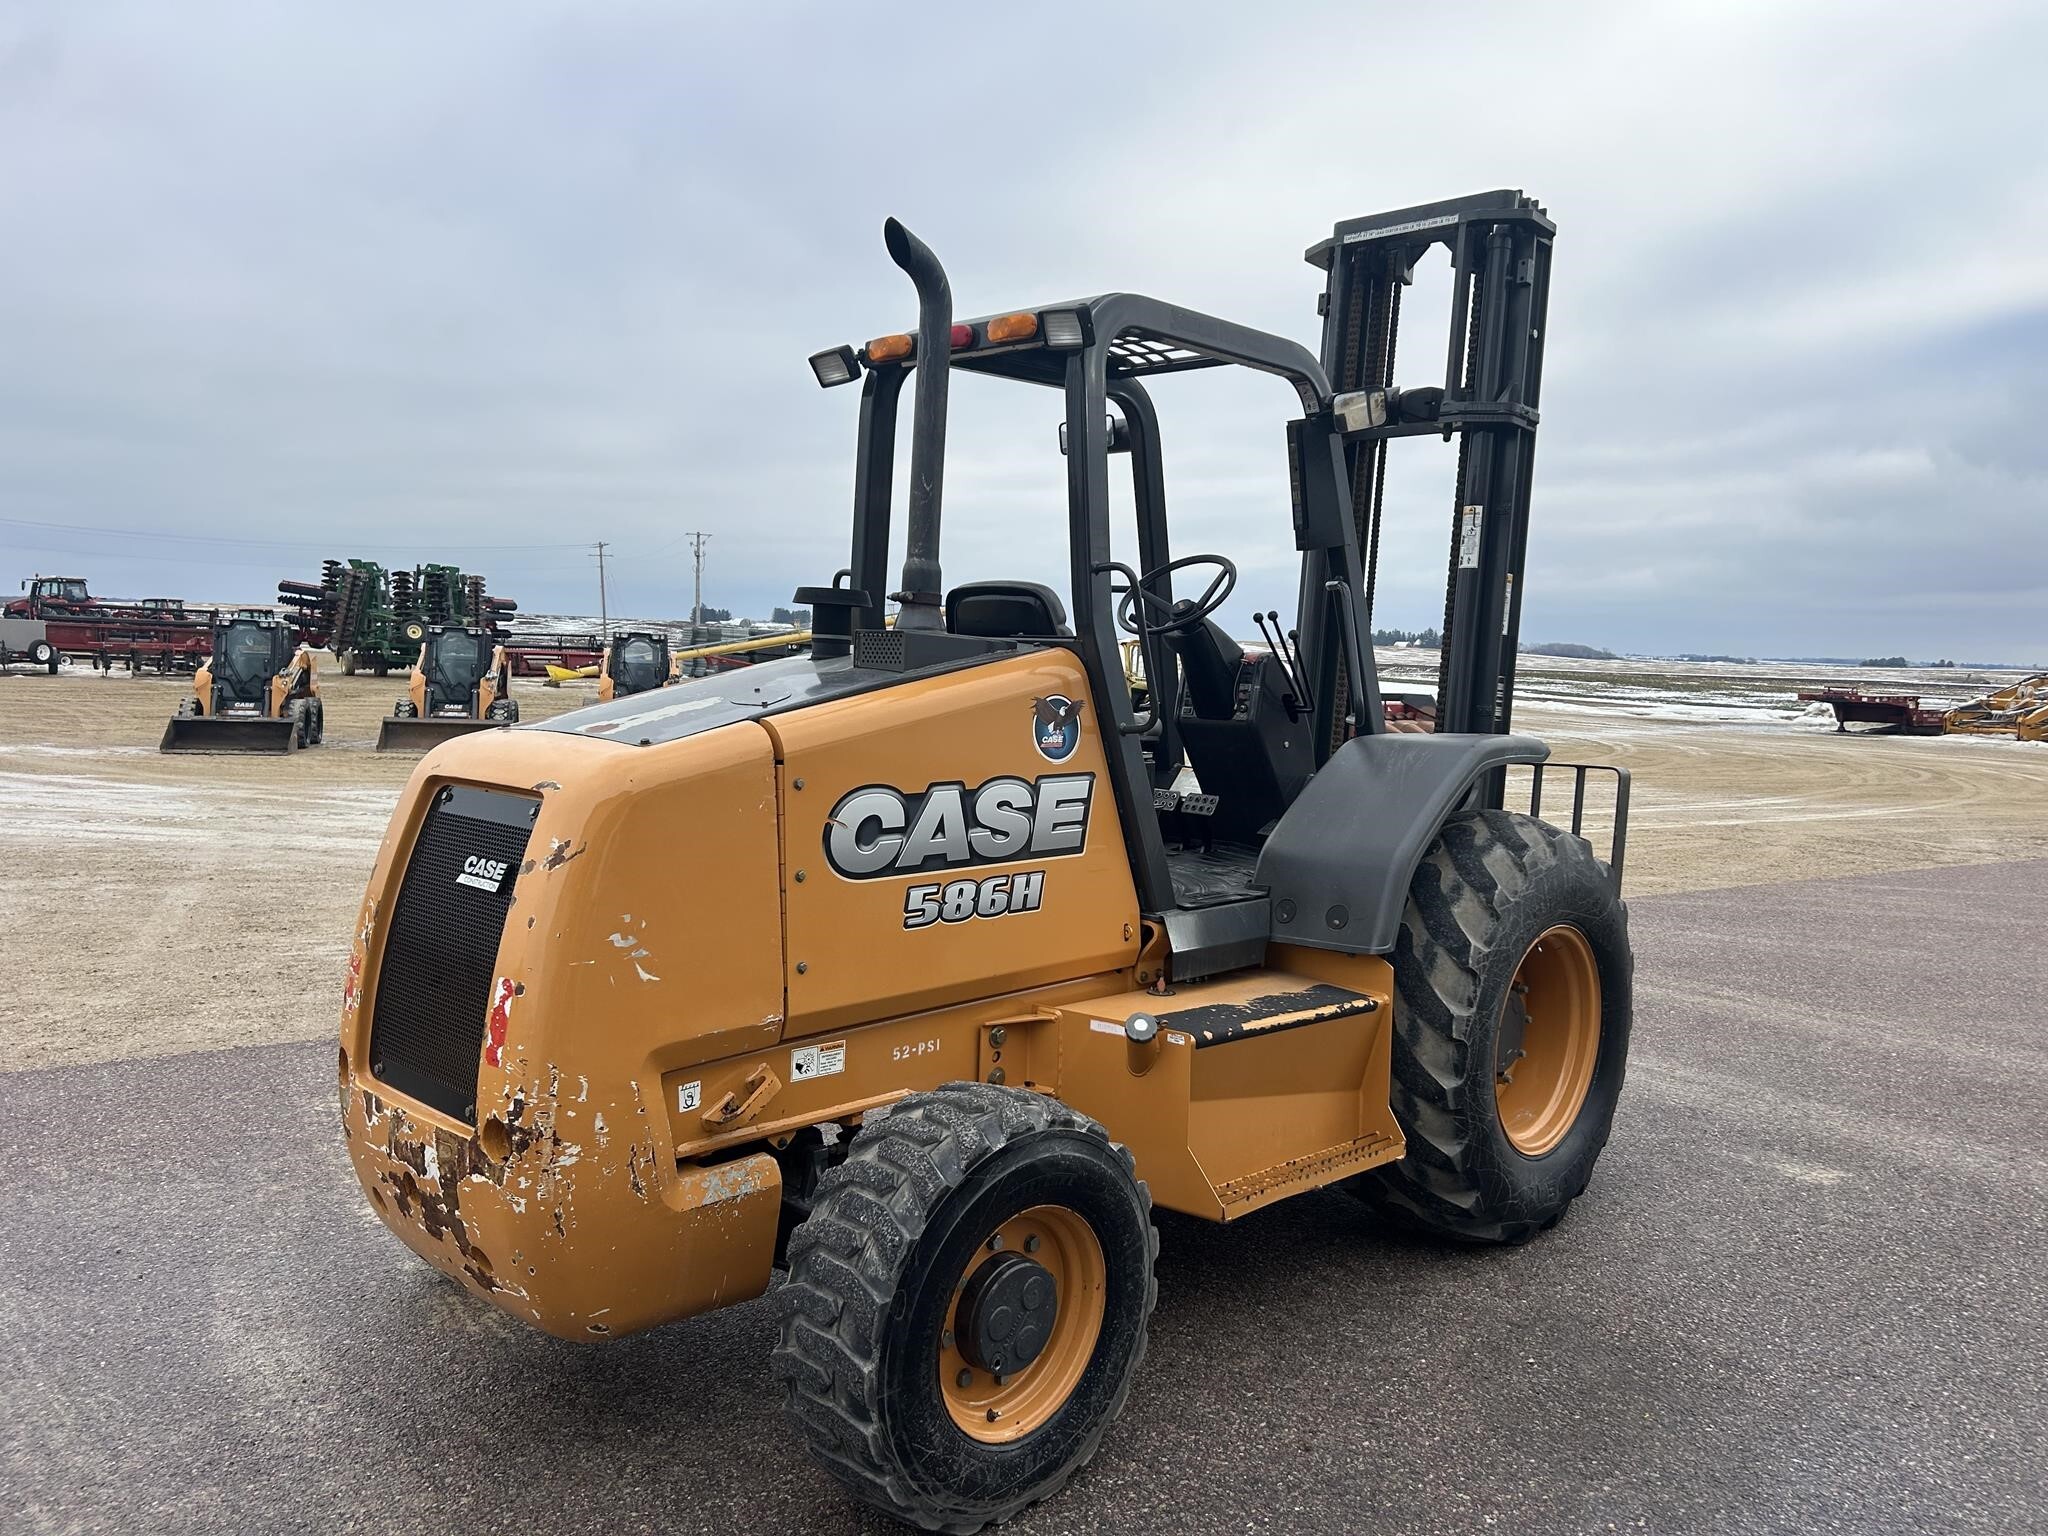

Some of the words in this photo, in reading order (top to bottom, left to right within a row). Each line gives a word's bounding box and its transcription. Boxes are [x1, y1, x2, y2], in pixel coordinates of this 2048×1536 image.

[1041, 735, 1064, 744] CASE
[824, 775, 1095, 880] CASE
[463, 855, 508, 881] CASE
[903, 871, 1046, 929] 586H
[892, 1038, 941, 1061] 52-PSI
